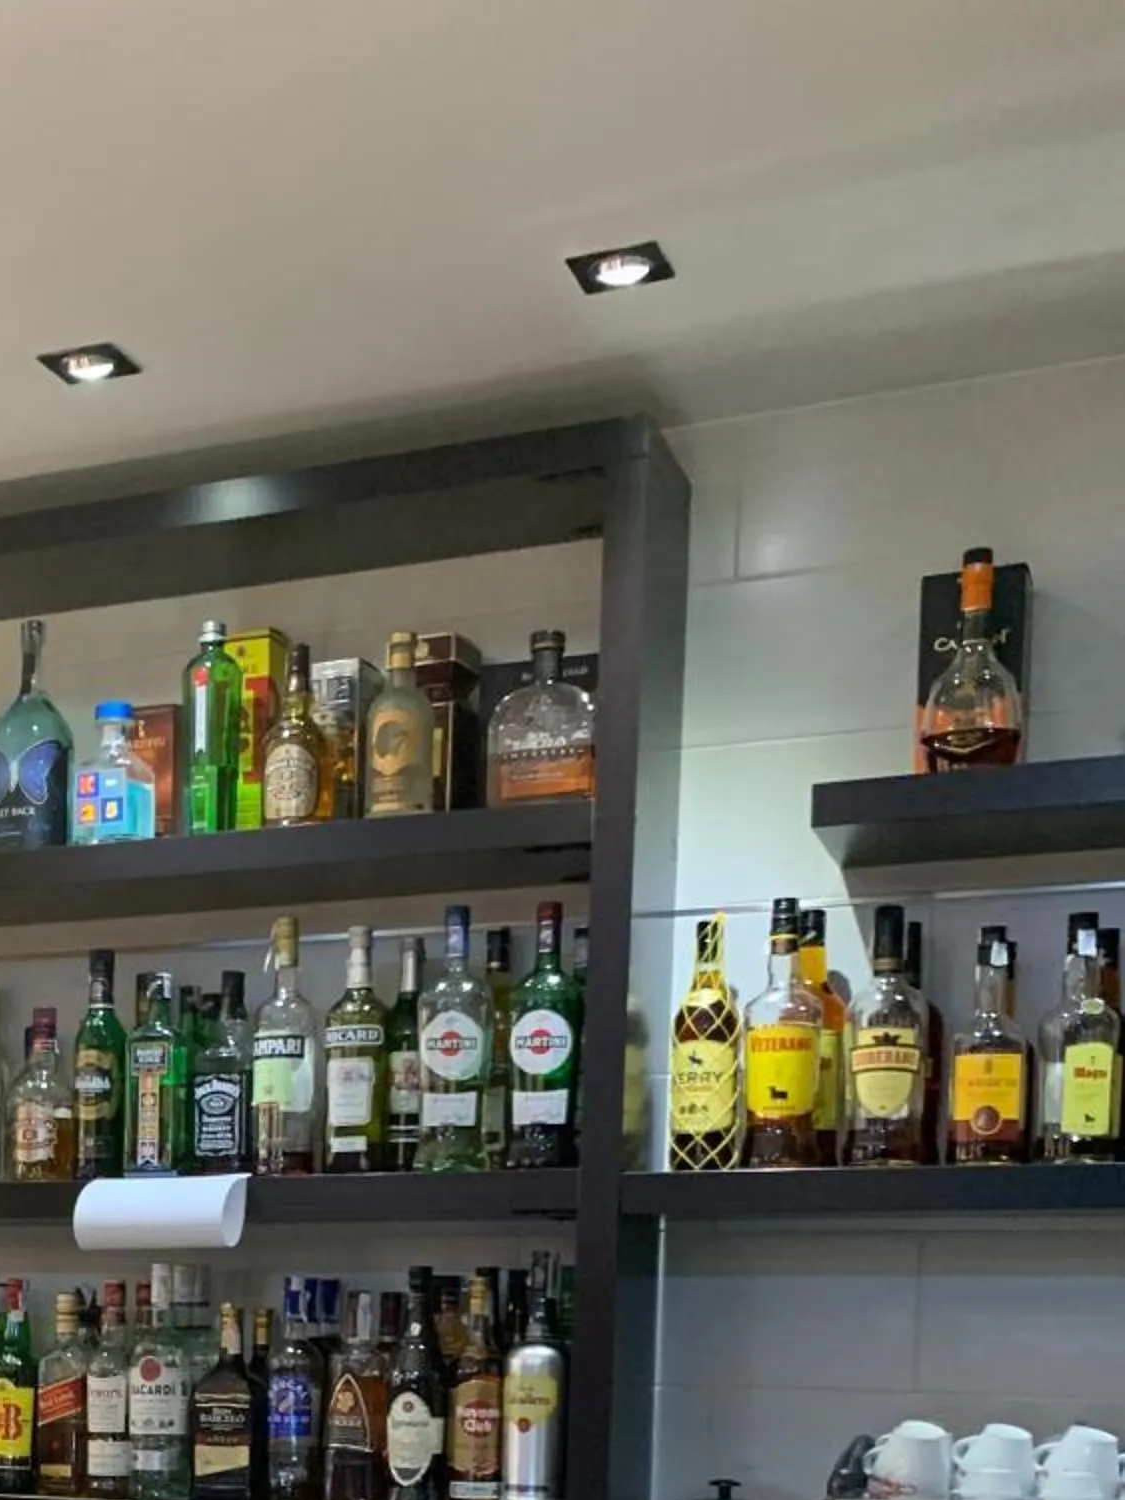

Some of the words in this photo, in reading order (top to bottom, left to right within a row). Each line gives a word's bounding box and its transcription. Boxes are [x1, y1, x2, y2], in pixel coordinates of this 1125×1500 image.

[255, 1038, 302, 1056] AMPARI
[427, 1037, 477, 1050] MARTINI
[515, 1036, 568, 1049] MARTINI
[677, 1071, 725, 1085] ERRY
[133, 1384, 177, 1396] ACARDI
